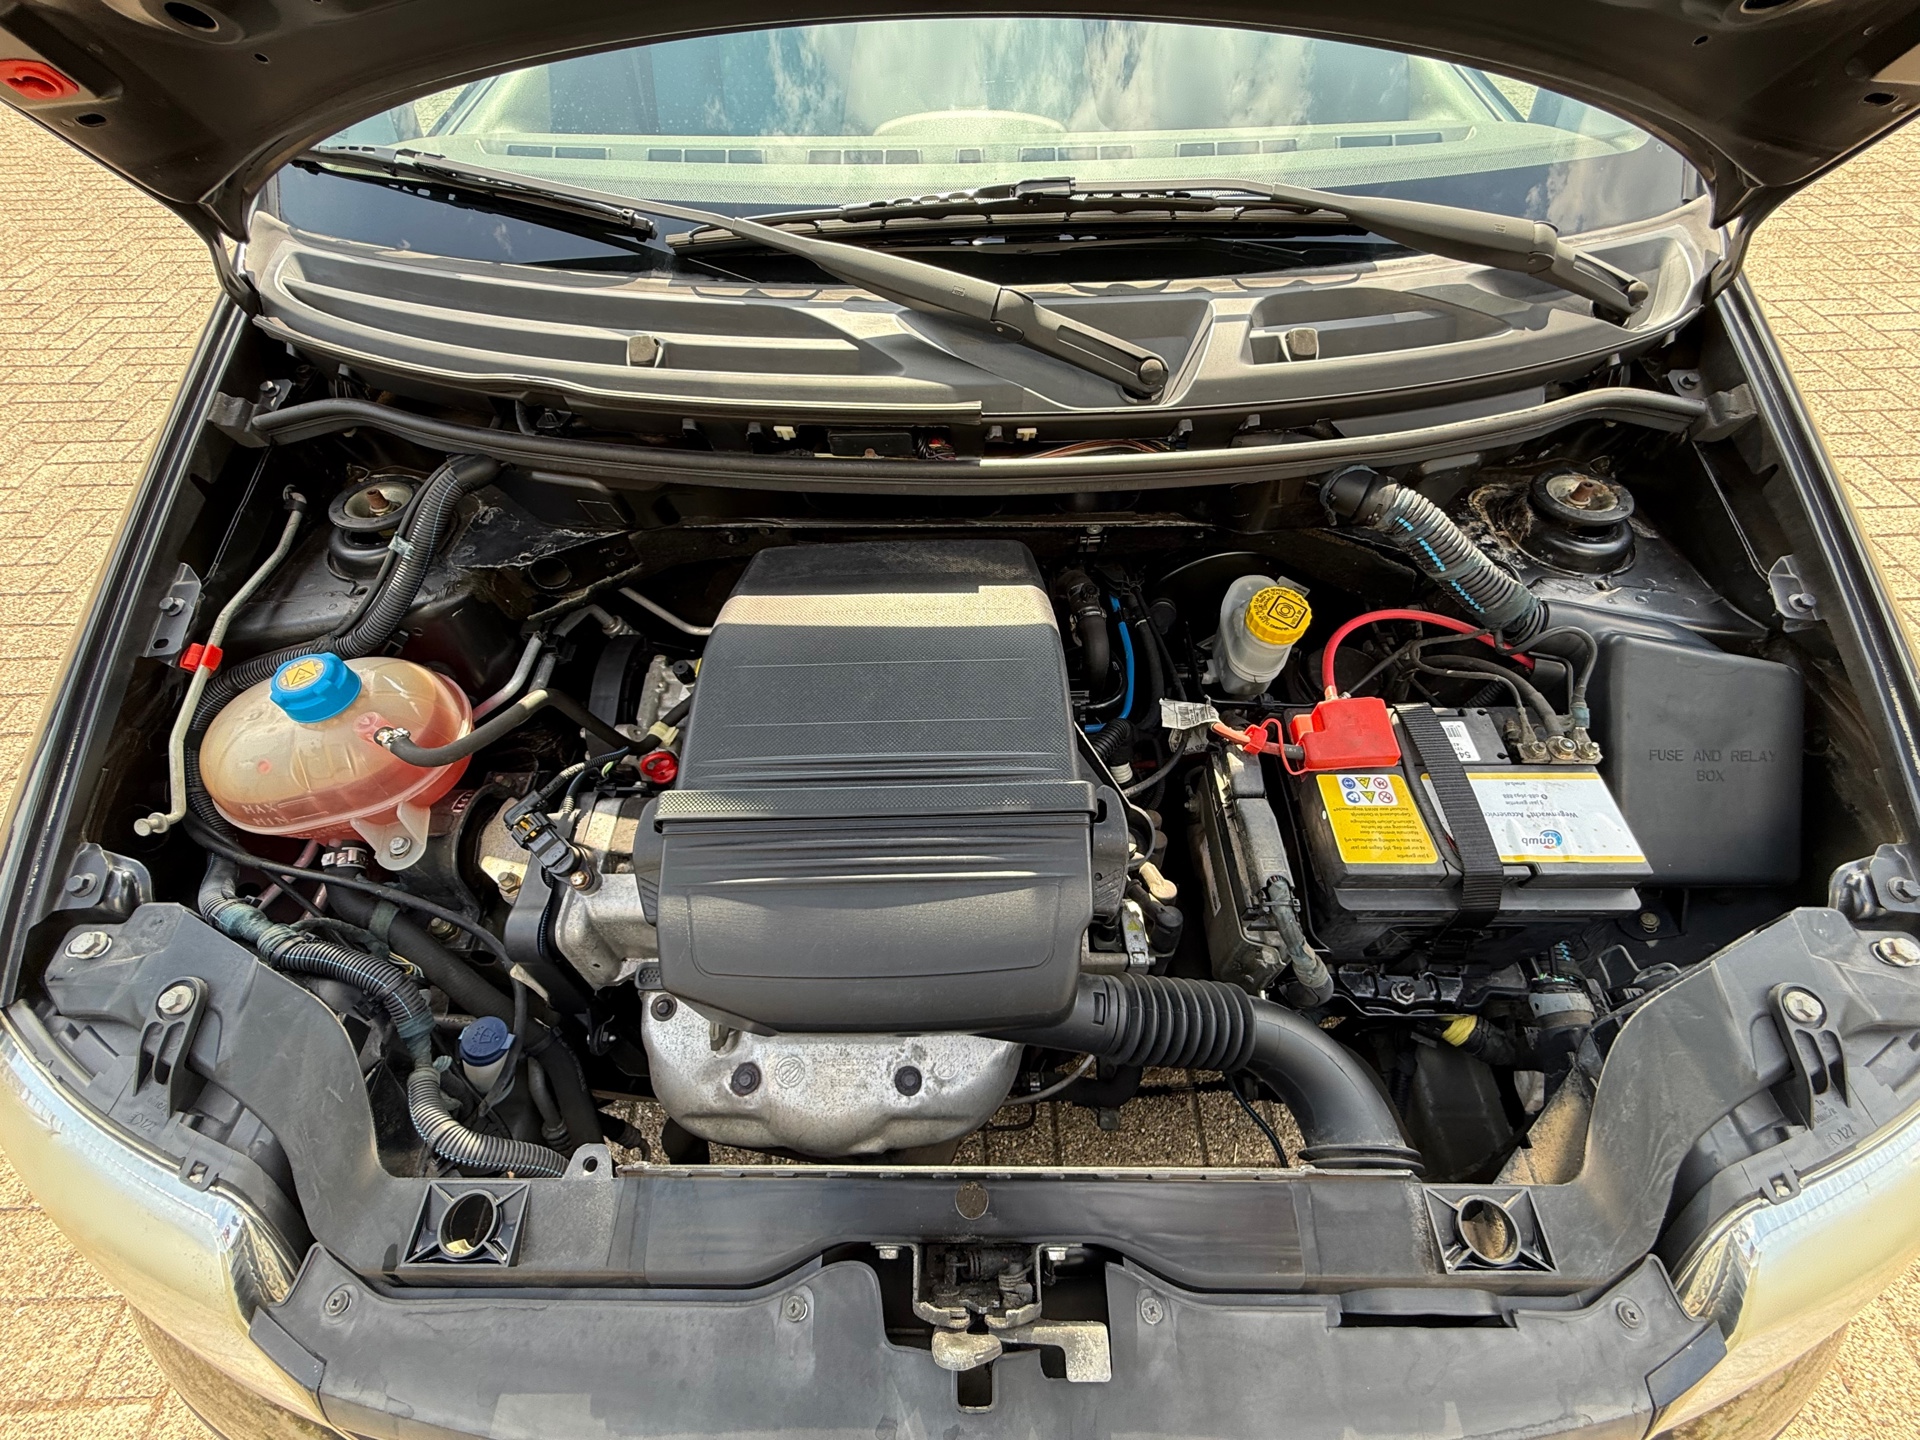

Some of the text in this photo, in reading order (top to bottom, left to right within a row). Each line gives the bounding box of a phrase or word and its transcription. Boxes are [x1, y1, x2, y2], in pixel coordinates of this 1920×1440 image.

[1649, 749, 1777, 763] FUSE AND RELAY
[1696, 769, 1725, 782] BOX
[241, 803, 277, 814] MAX
[252, 816, 289, 826] MIN
[1521, 838, 1554, 846] anwb
